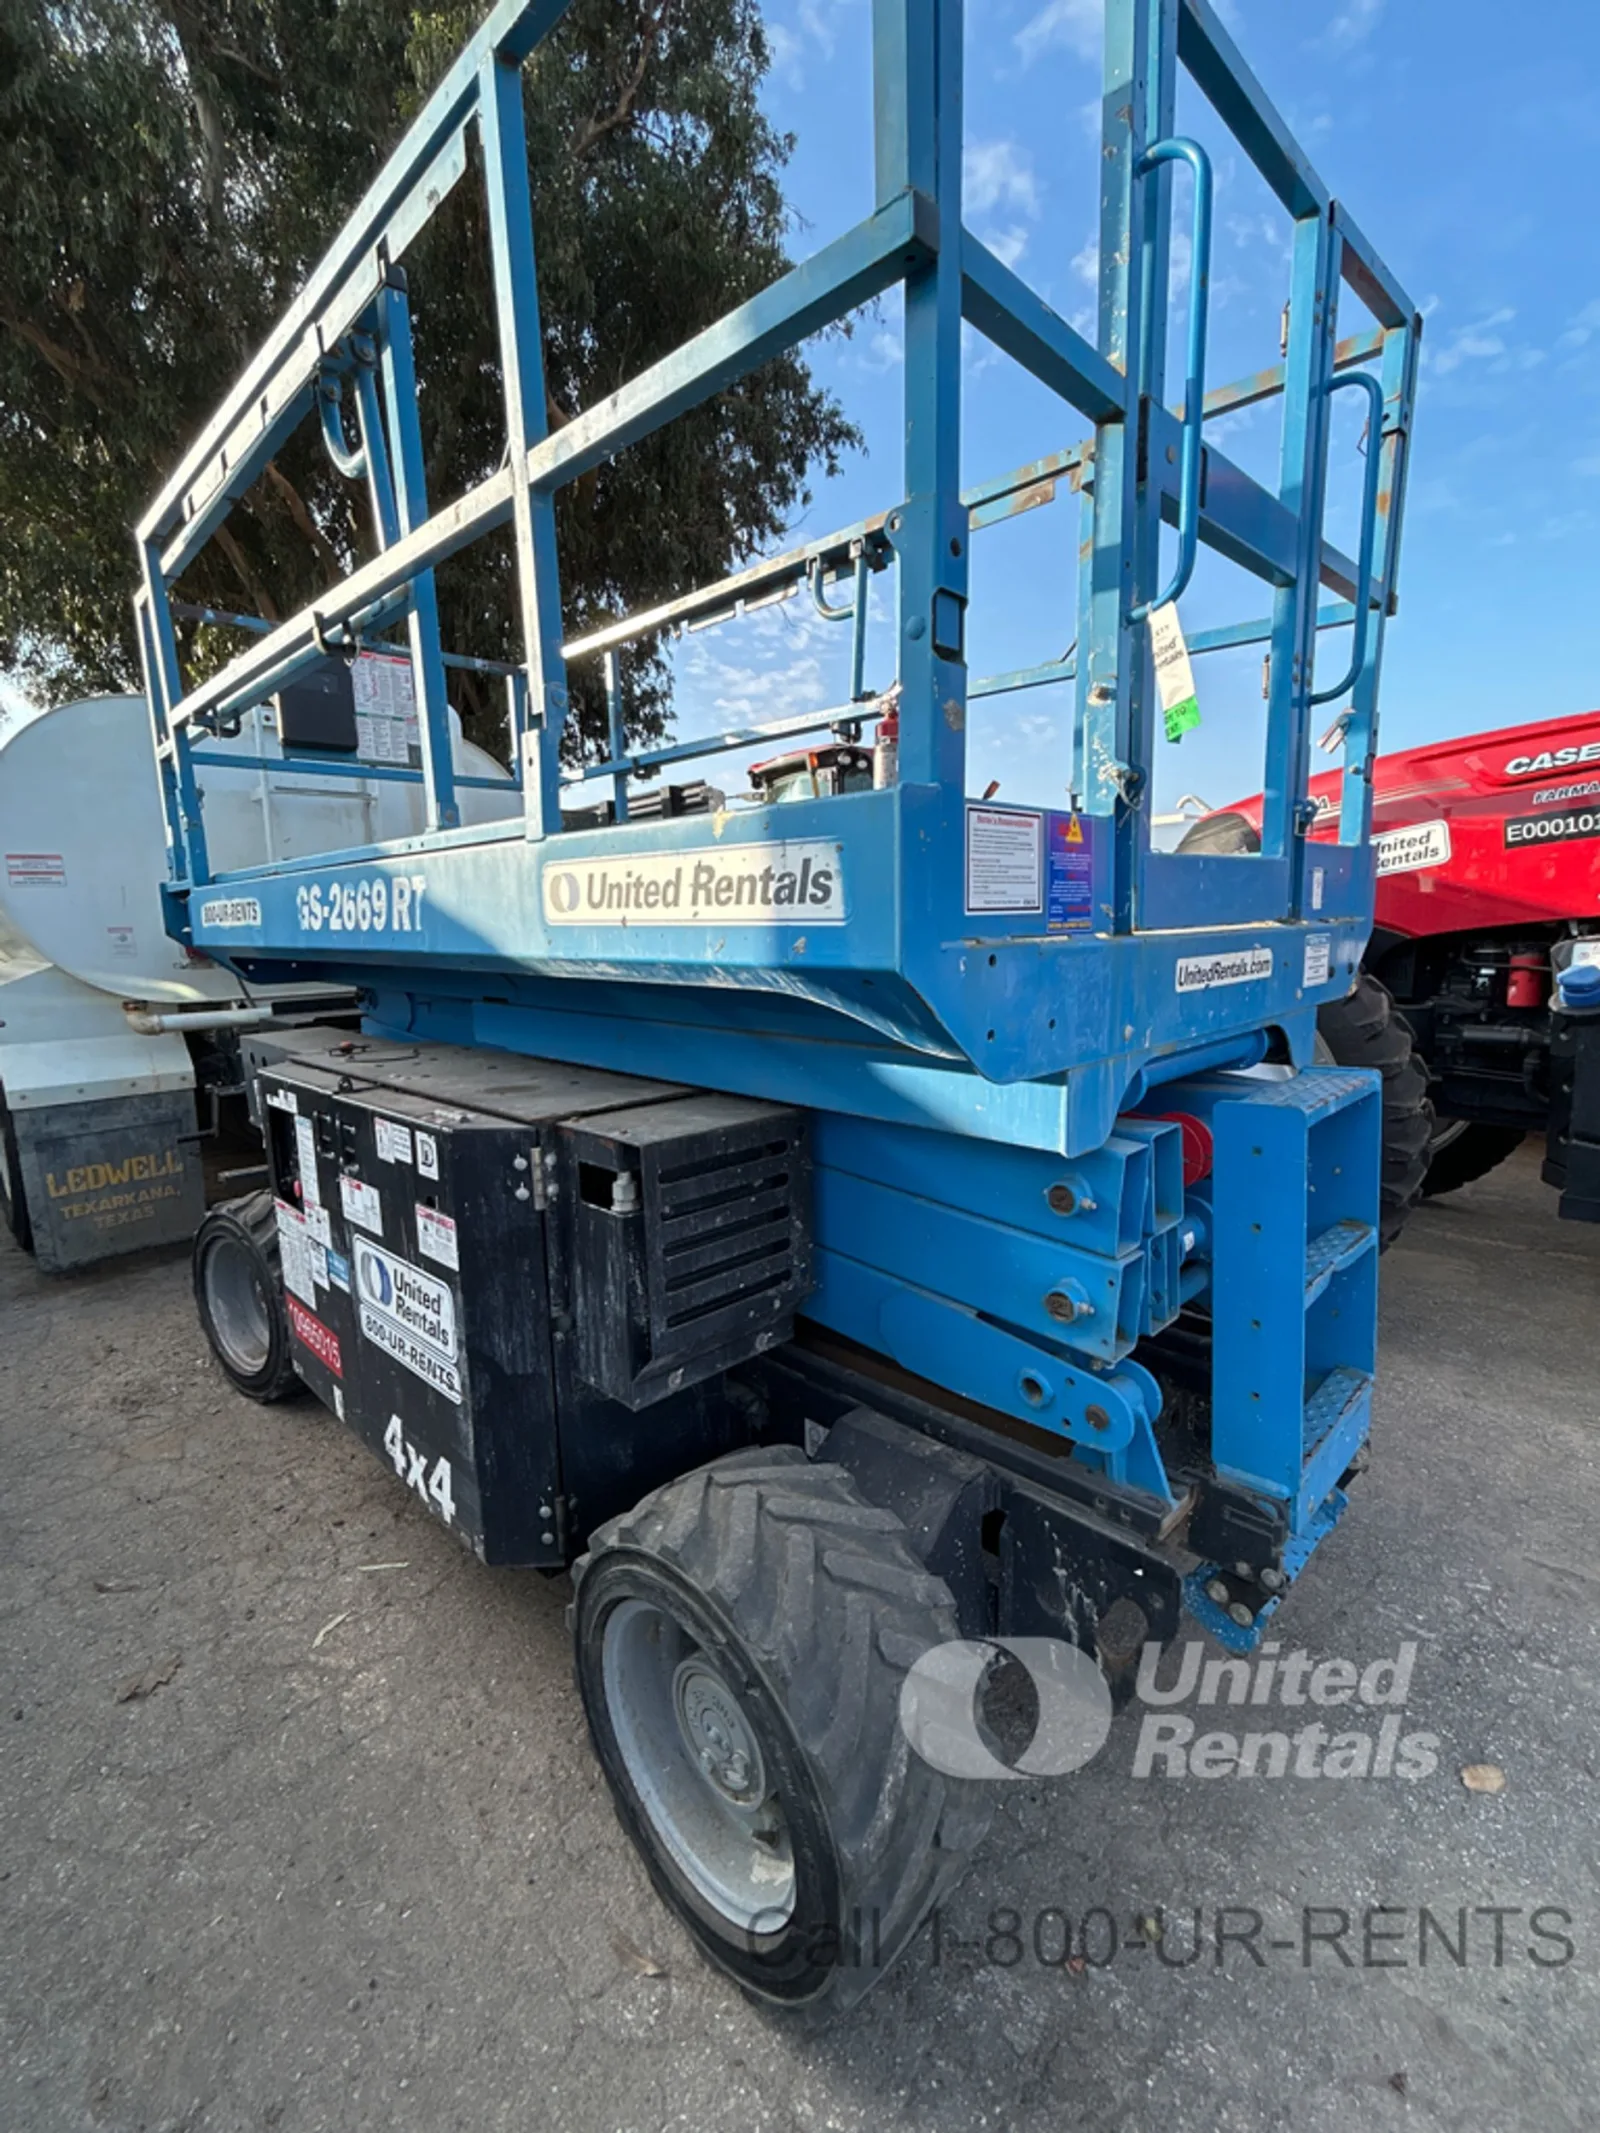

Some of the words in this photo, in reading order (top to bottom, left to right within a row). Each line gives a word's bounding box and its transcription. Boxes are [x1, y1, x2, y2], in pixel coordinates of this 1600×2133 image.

[296, 878, 387, 932] GS-2669
[391, 875, 427, 932] RT
[586, 866, 683, 910] United
[690, 857, 833, 908] Rentals
[1178, 957, 1271, 987] UnitedRentals.com
[46, 1151, 185, 1198] LEDWELL
[60, 1184, 182, 1219] TEXARKANA,
[93, 1204, 156, 1230] TEXAS
[393, 1268, 442, 1317] United
[395, 1293, 450, 1347] Rentals
[364, 1314, 457, 1393] 800-UR-RENTS
[383, 1413, 456, 1524] 4x4
